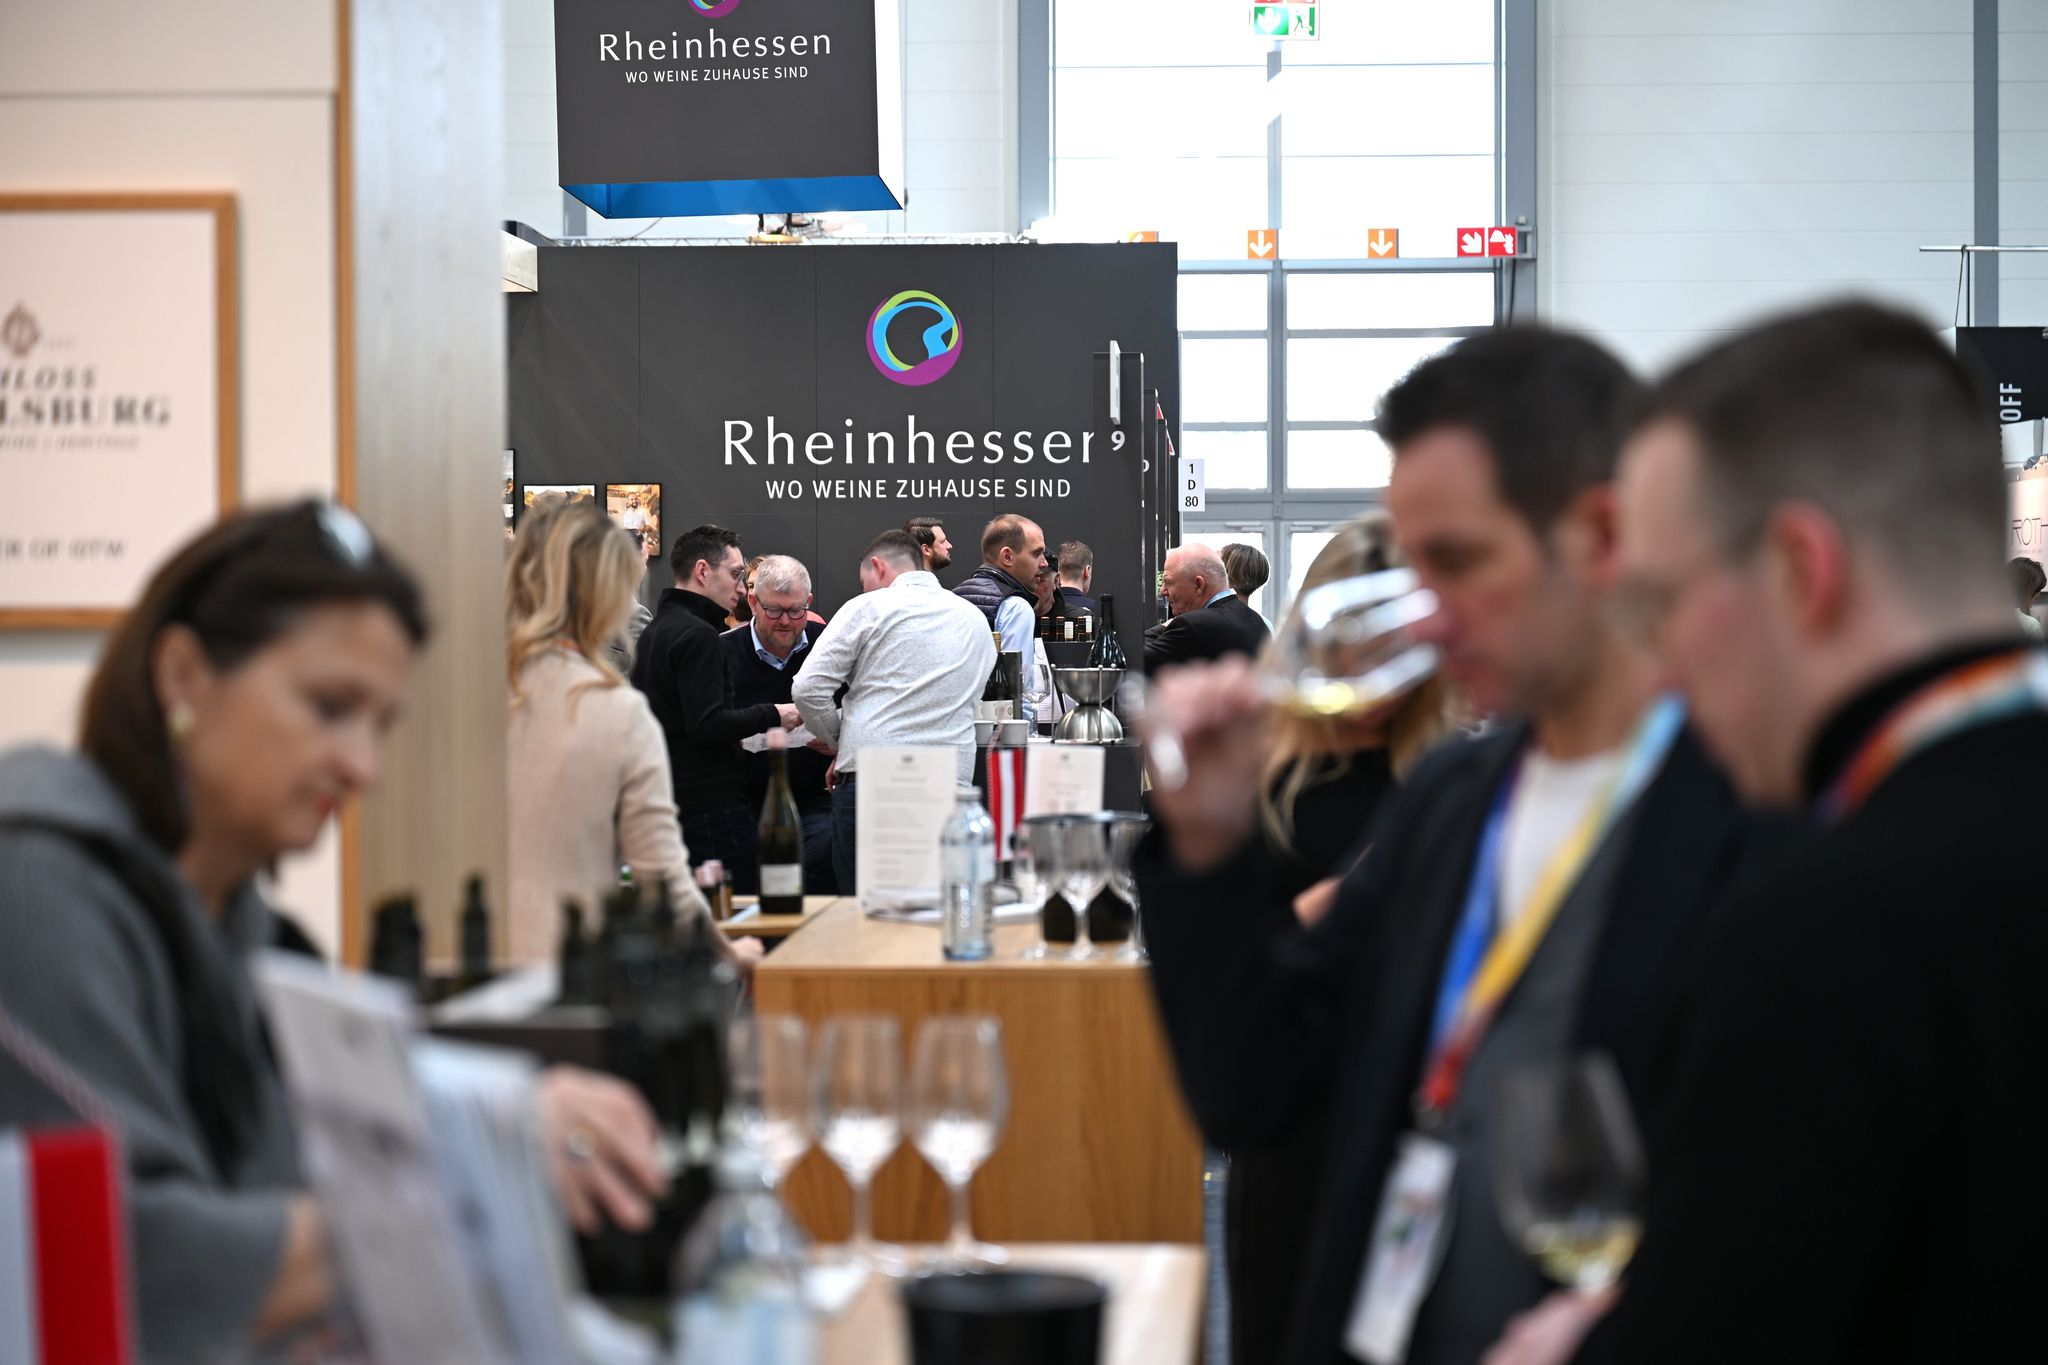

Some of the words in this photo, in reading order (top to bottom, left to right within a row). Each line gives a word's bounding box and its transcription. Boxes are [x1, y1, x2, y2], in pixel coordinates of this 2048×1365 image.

[599, 28, 832, 61] Rheinhessen
[625, 70, 648, 84] WO
[653, 69, 699, 83] WEINE
[703, 67, 770, 81] ZUHAUSE
[774, 66, 808, 79] SIND
[2000, 382, 2022, 423] OFF
[1110, 430, 1126, 451] 9
[1188, 463, 1194, 475] 1
[765, 479, 803, 499] WO
[812, 479, 887, 499] WEINE
[896, 478, 1006, 499] ZUHAUSE
[1015, 478, 1071, 498] SIND
[1187, 479, 1196, 490] D
[1185, 495, 1199, 508] 80
